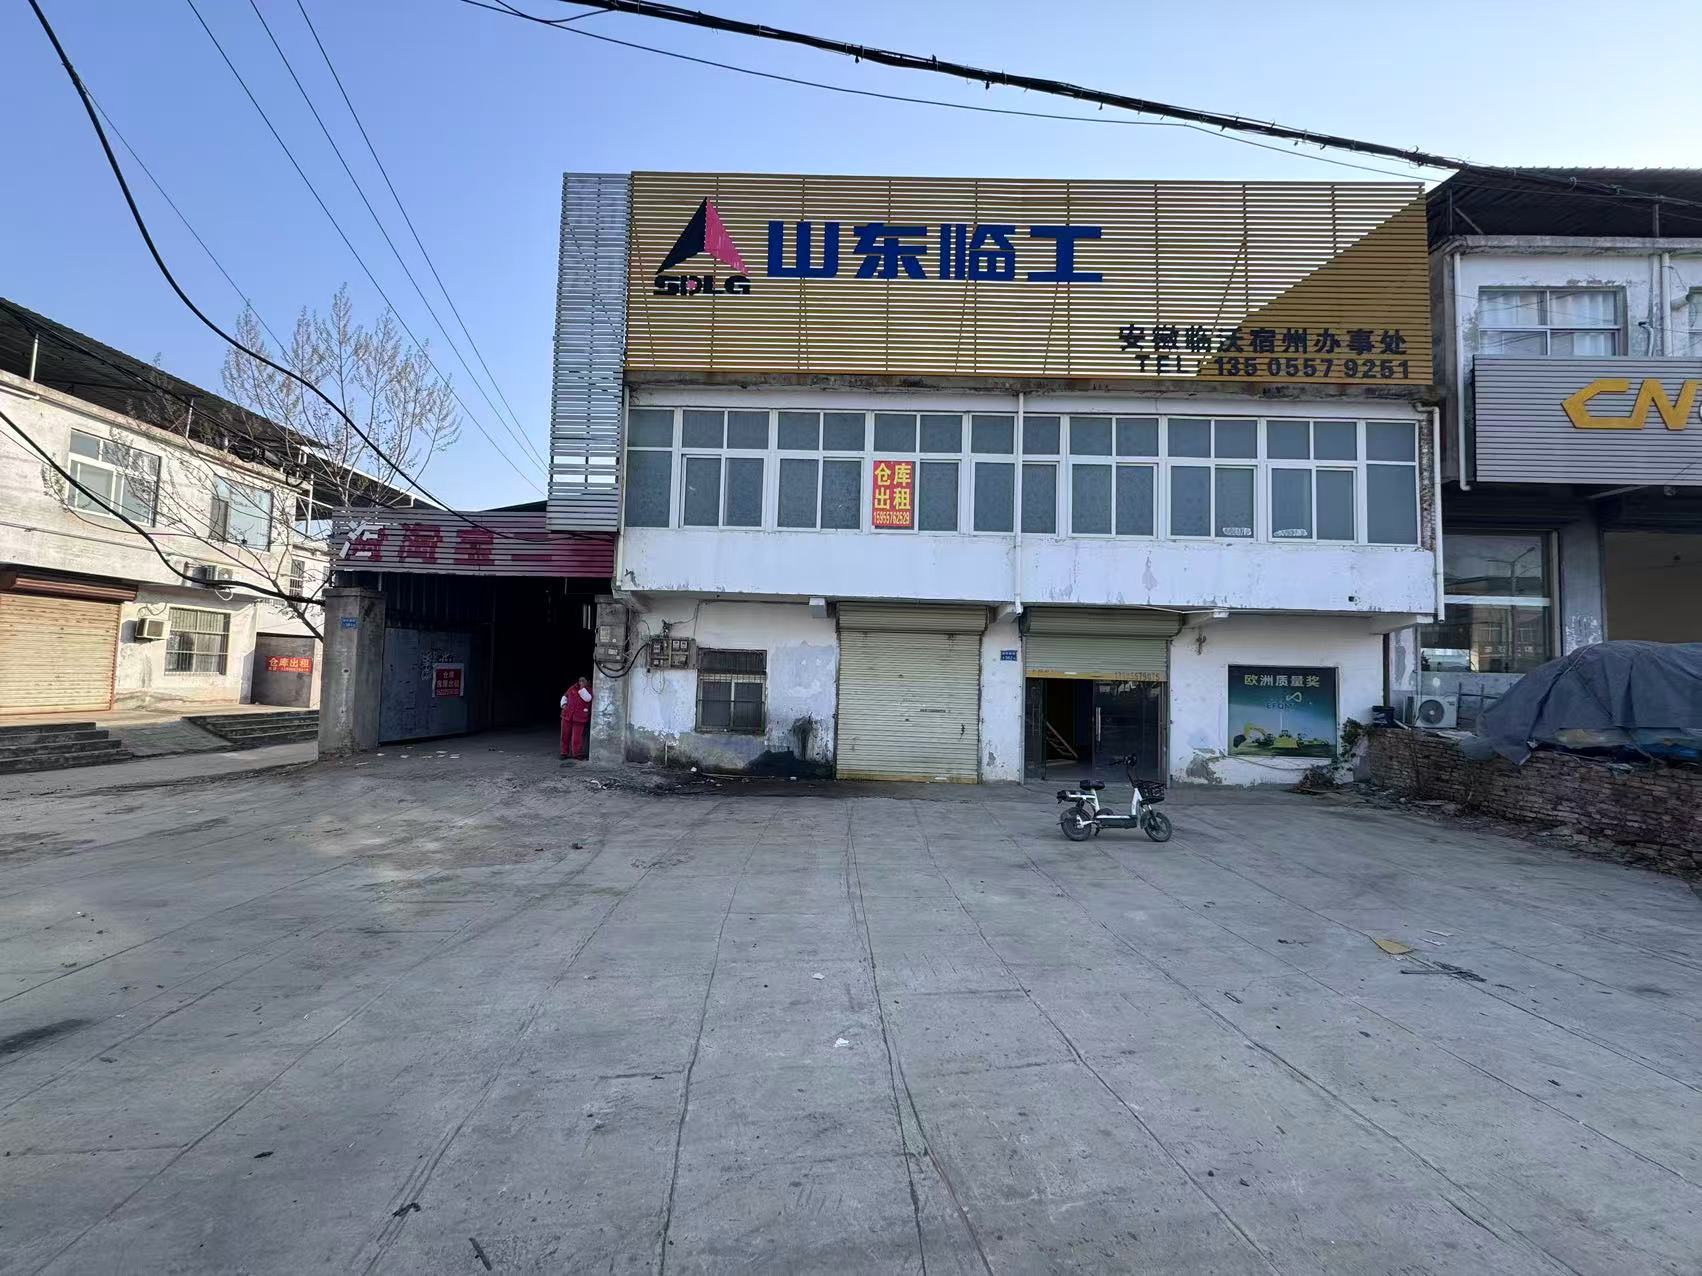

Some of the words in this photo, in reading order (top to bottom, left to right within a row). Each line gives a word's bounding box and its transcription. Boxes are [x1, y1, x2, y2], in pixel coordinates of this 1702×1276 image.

[766, 220, 1103, 283] 山东临工
[653, 274, 752, 296] SDLG
[874, 463, 912, 486] 仓库
[874, 487, 911, 510] 出租
[269, 657, 310, 668] 仓库出租
[1244, 674, 1320, 687] 欧洲质量奖
